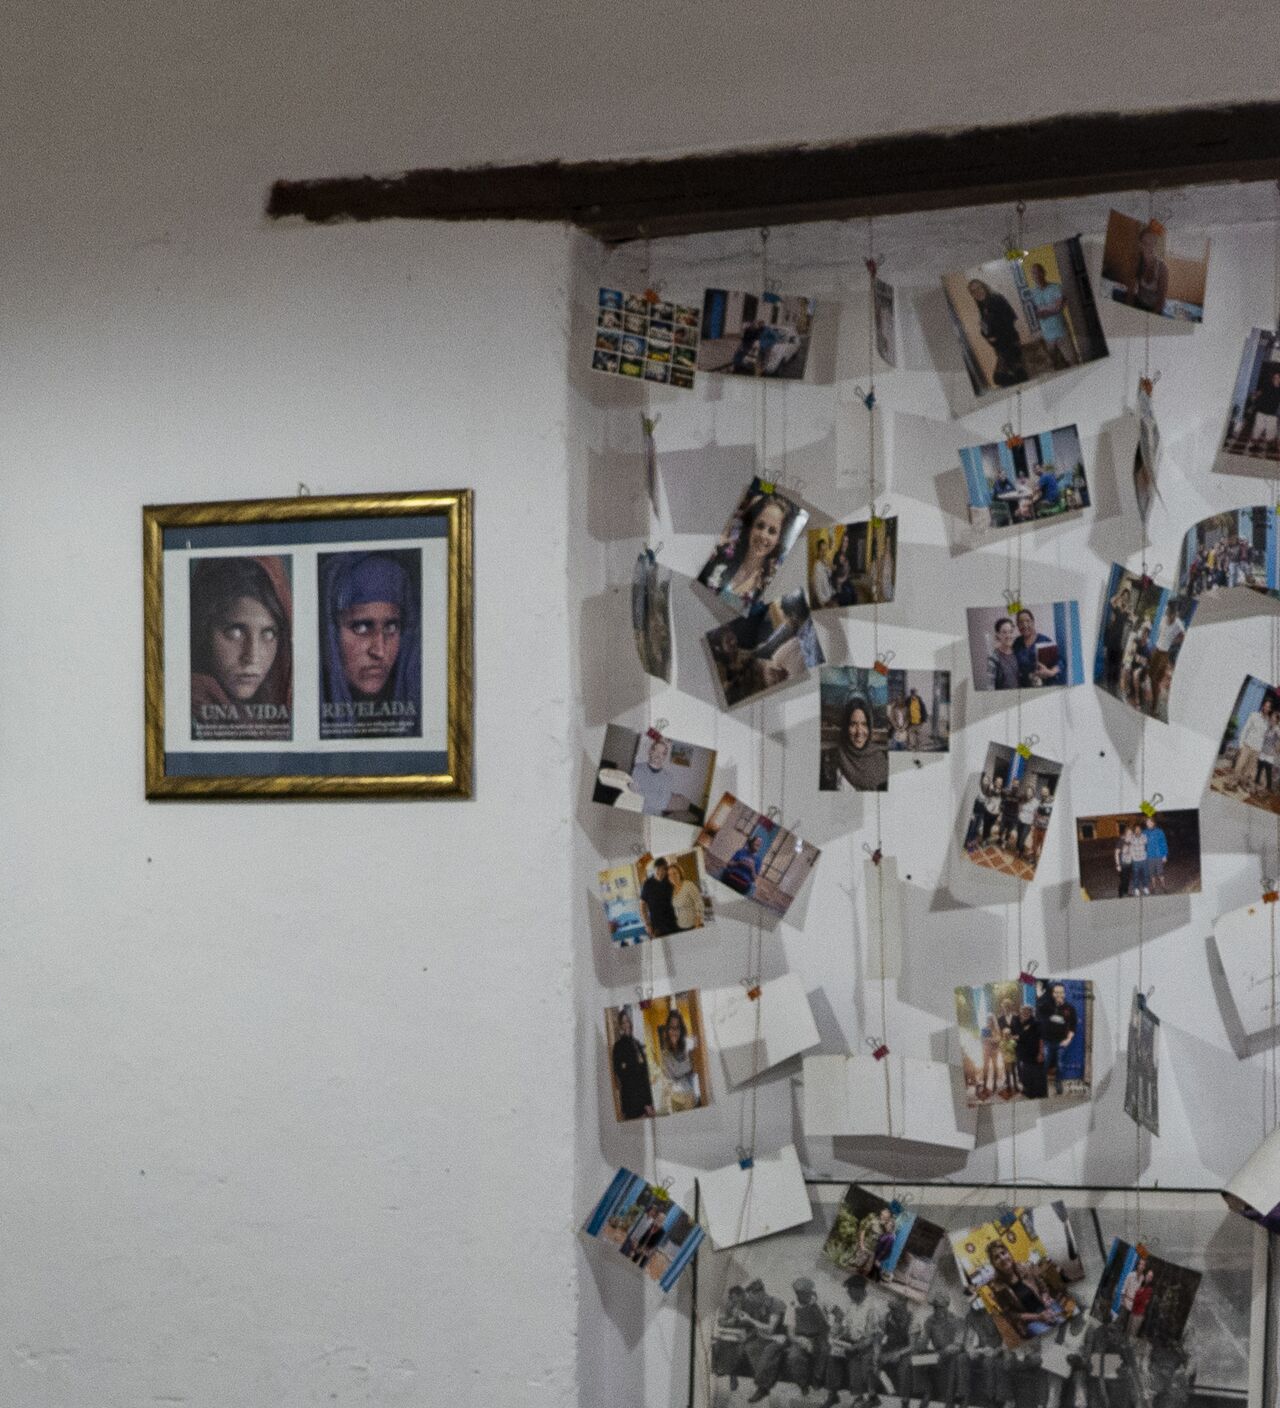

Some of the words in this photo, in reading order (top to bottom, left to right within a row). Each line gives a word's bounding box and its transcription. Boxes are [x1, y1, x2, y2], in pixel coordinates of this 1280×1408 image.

[201, 704, 240, 720] UNA
[245, 703, 289, 720] VIDA
[322, 701, 417, 719] REVELADA
